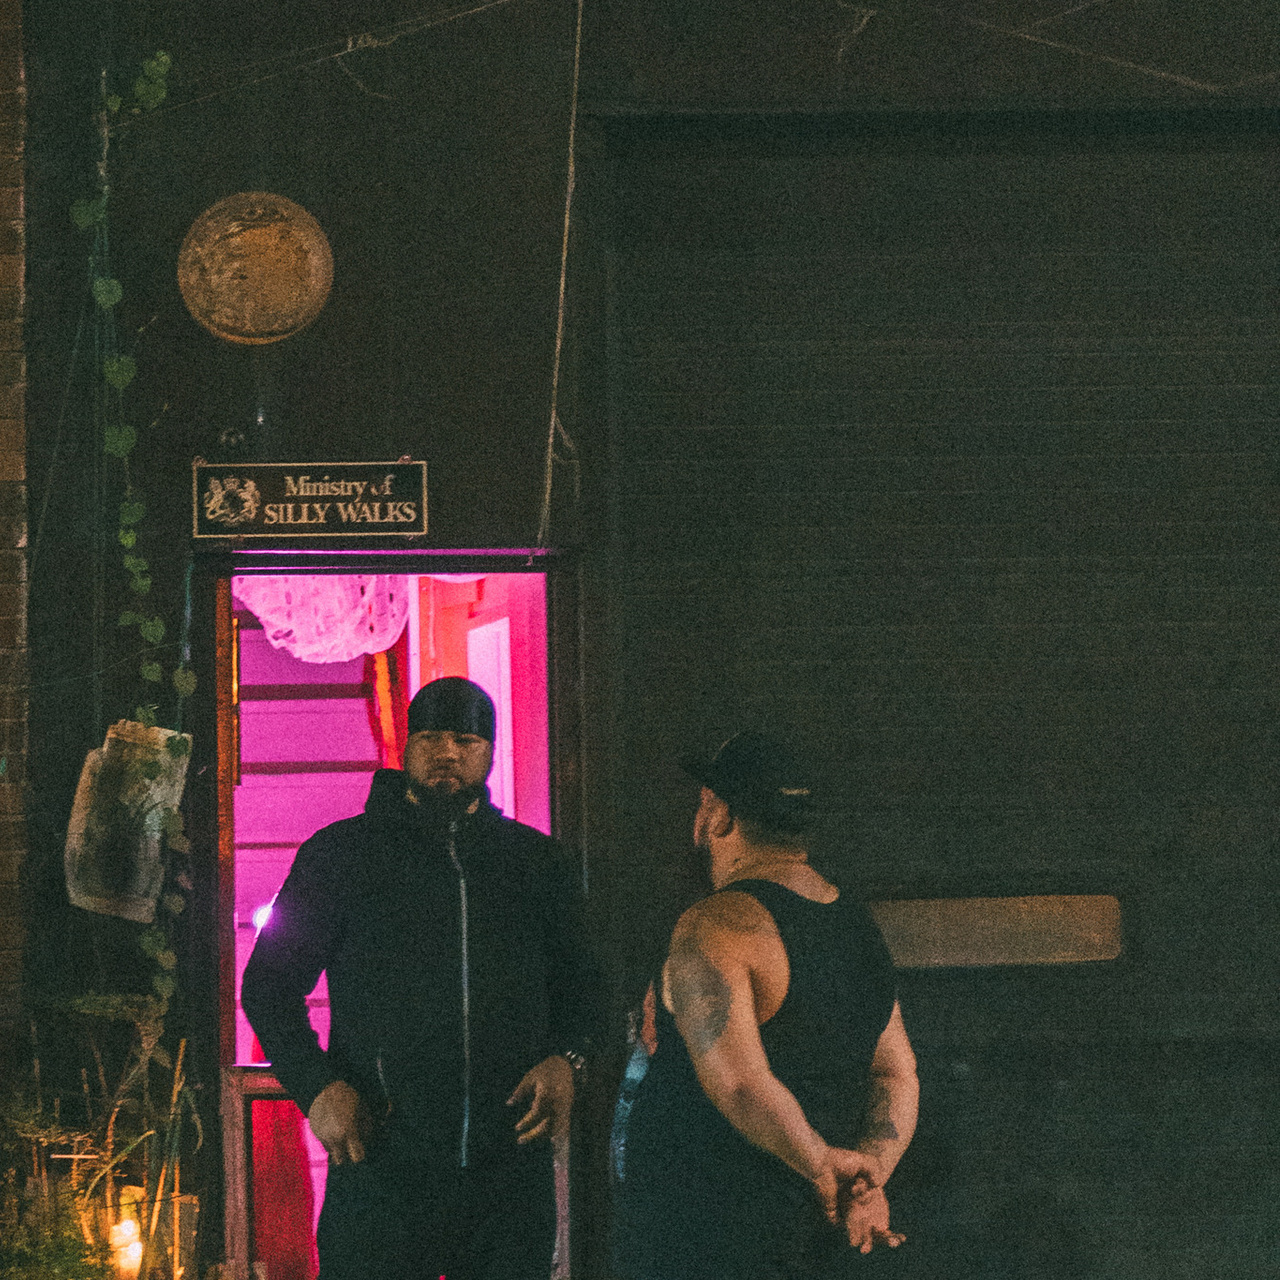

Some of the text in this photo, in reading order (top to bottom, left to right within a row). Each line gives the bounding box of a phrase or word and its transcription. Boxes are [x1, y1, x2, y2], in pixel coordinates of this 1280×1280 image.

[284, 473, 397, 503] Ministry of
[263, 501, 417, 525] SILLY WALKS
